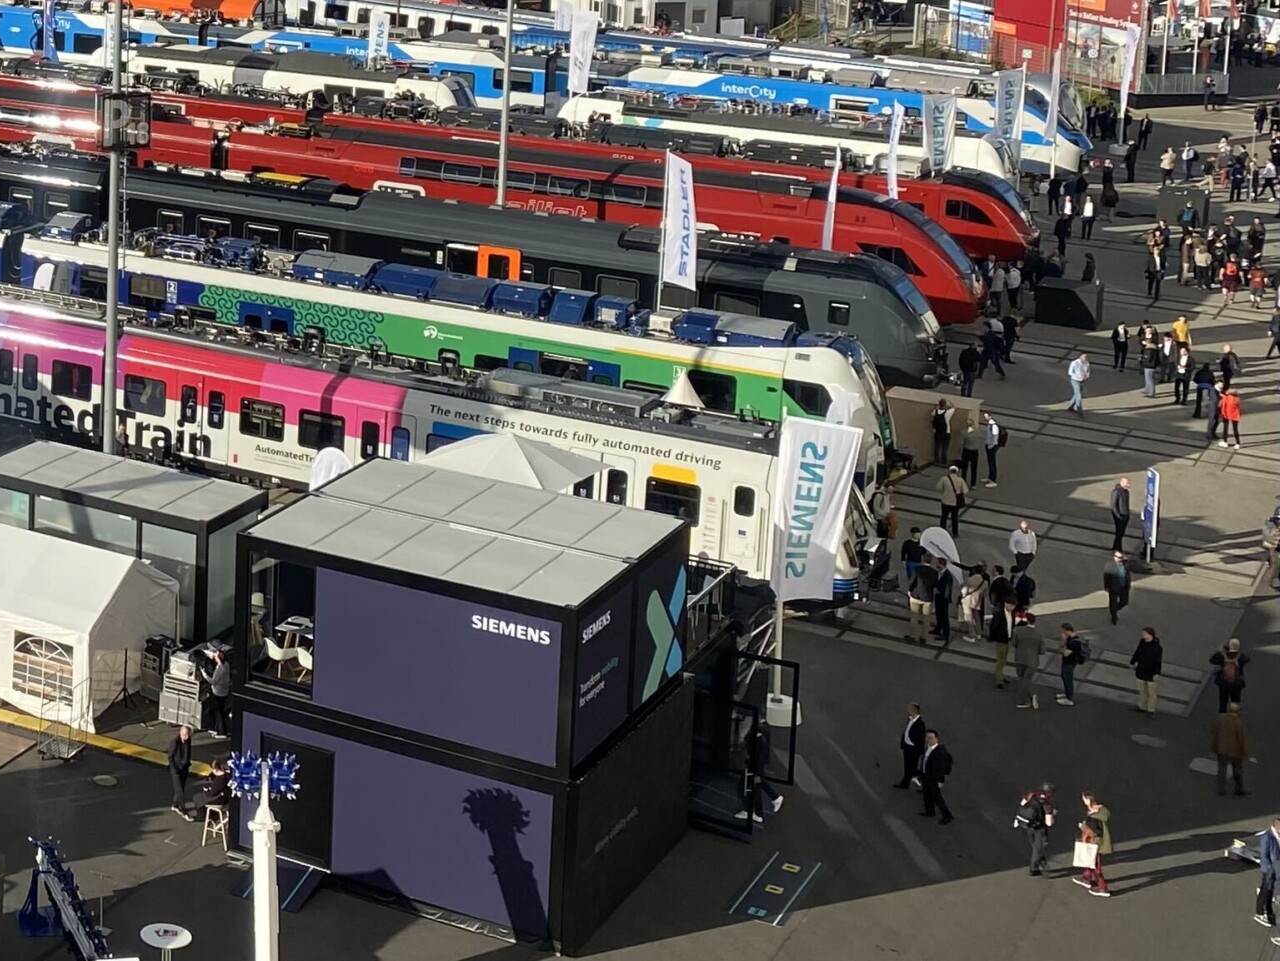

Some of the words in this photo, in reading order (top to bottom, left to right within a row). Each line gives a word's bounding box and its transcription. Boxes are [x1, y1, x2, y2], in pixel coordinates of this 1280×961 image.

[721, 82, 776, 100] interCity
[429, 404, 451, 417] The
[454, 410, 481, 422] next
[484, 415, 516, 430] steps
[519, 422, 568, 440] towards
[572, 431, 599, 448] fully
[602, 438, 671, 459] automated
[675, 450, 722, 471] driving
[255, 444, 314, 463] AutomatedTr
[472, 614, 551, 645] SIEMENS
[582, 610, 612, 643] SIEMENS
